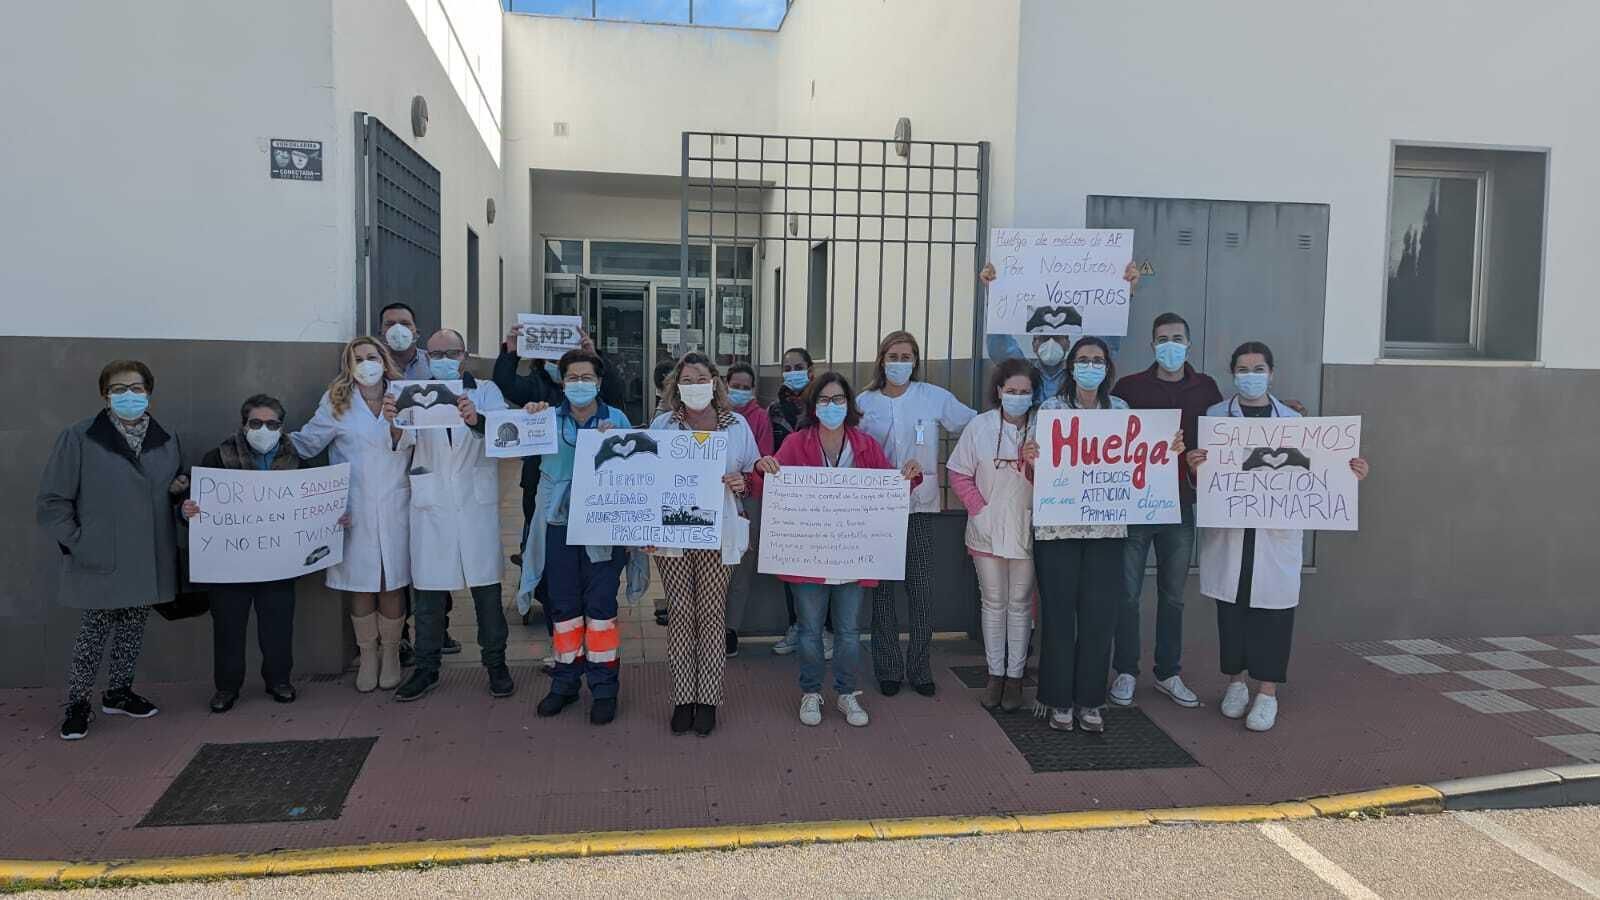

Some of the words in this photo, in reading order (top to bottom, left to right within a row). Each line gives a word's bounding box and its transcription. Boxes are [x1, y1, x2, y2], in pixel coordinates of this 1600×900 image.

[1034, 232, 1048, 246] de
[1040, 252, 1117, 275] Nosotros
[526, 327, 573, 344] SMP
[1207, 422, 1358, 451] SALVEMOS
[670, 433, 727, 461] SMP
[1051, 414, 1170, 490] Huelga
[1219, 447, 1238, 466] LA
[674, 474, 698, 488] DE
[1052, 468, 1072, 488] de
[199, 476, 243, 504] POR
[253, 486, 295, 502] UNA
[661, 491, 697, 506] PARA
[1137, 485, 1176, 520] digna
[1225, 494, 1350, 521] PRIMARIA
[268, 512, 286, 522] EN
[586, 508, 656, 523] NUESTROS
[200, 535, 214, 552] Y
[225, 536, 250, 552] NO
[258, 536, 281, 550] EN
[611, 524, 718, 544] PACIENTES
